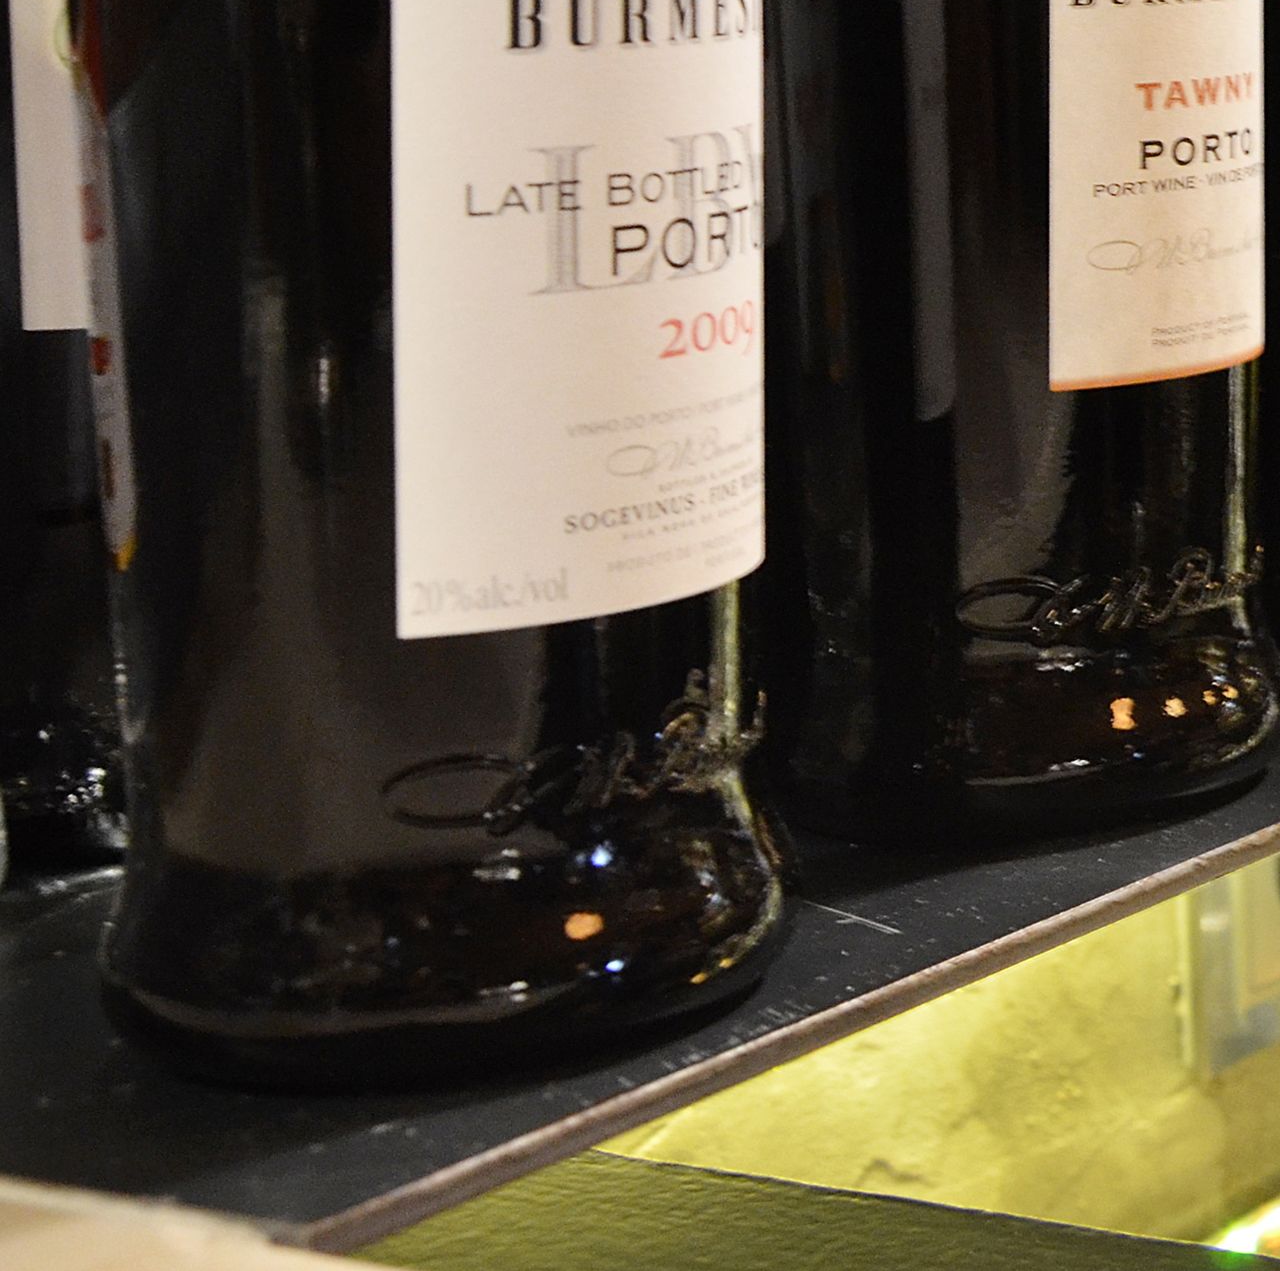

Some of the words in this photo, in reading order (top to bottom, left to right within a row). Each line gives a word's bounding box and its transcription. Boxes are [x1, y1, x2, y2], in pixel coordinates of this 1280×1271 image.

[1135, 73, 1254, 110] TAWNY
[465, 179, 582, 217] LATE
[607, 161, 743, 207] BOTTLED
[1093, 181, 1147, 197] PORT
[1152, 175, 1196, 191] WINE
[658, 300, 755, 358] 2009
[564, 493, 696, 535] SOGEVINUS
